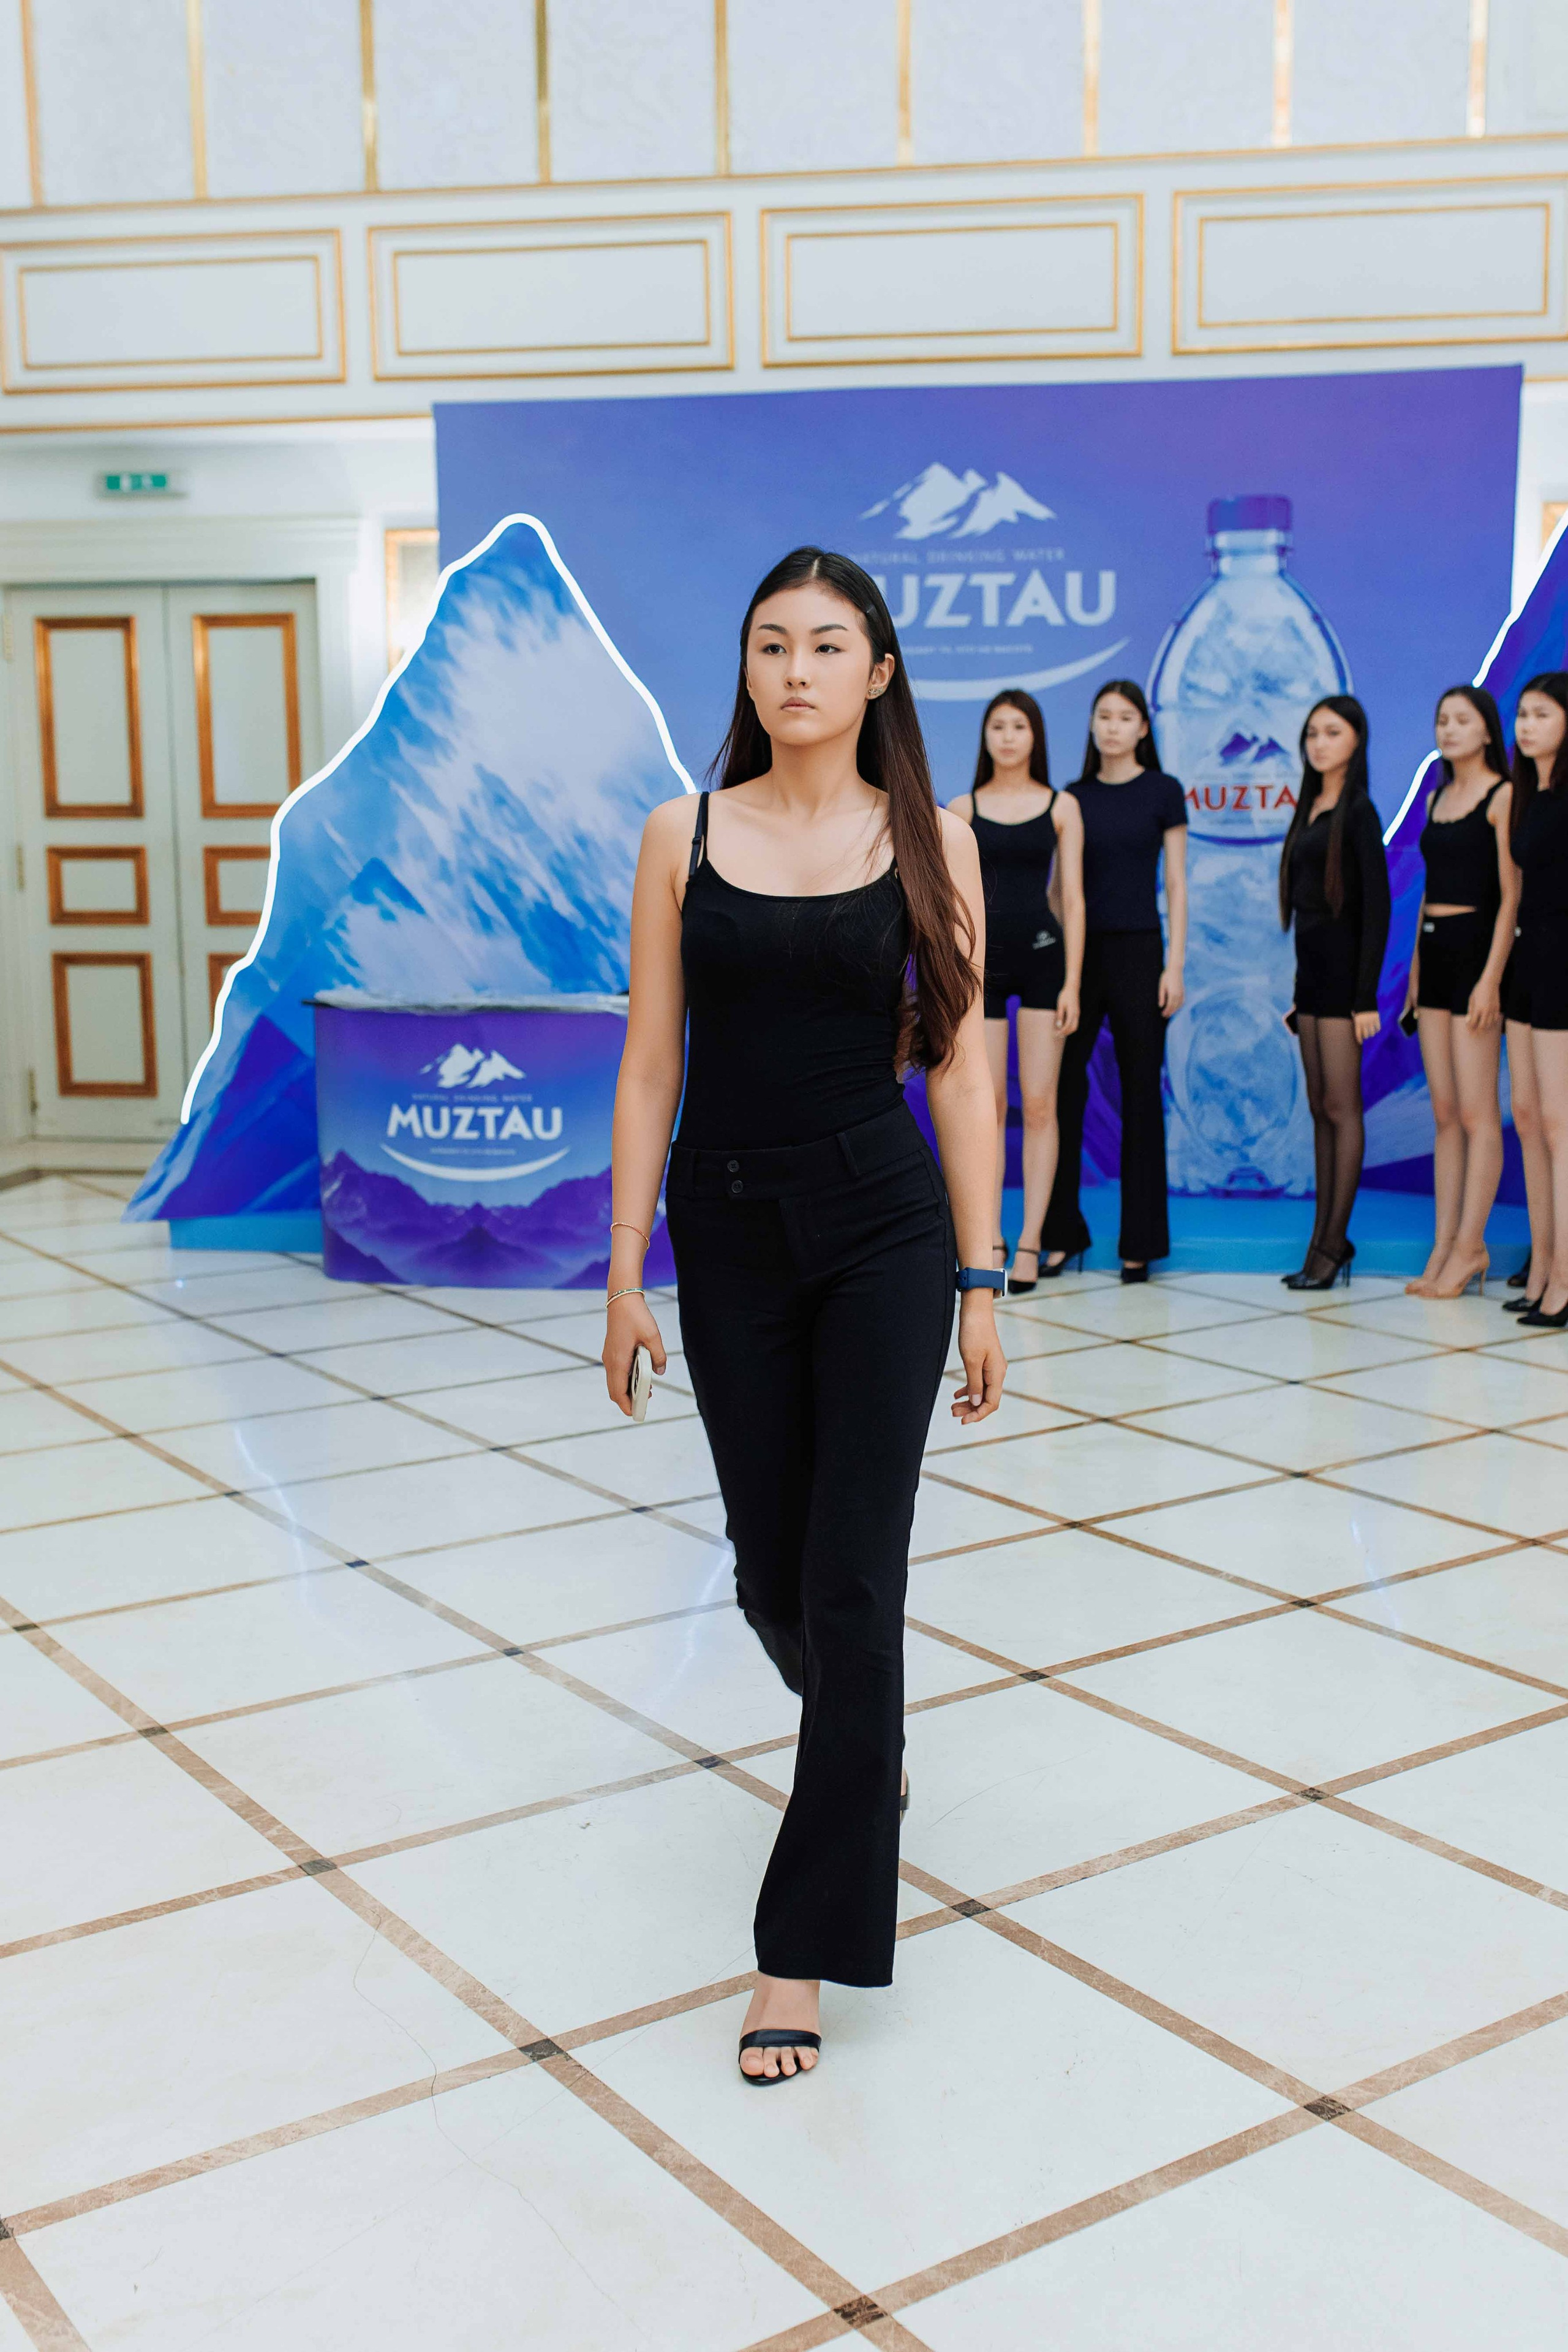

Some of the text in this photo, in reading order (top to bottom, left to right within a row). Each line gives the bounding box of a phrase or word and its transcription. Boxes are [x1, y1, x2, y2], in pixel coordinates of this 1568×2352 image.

[1012, 548, 1065, 562] WATER
[871, 569, 1117, 628] UZTAU
[386, 1103, 564, 1140] MUZTAU
